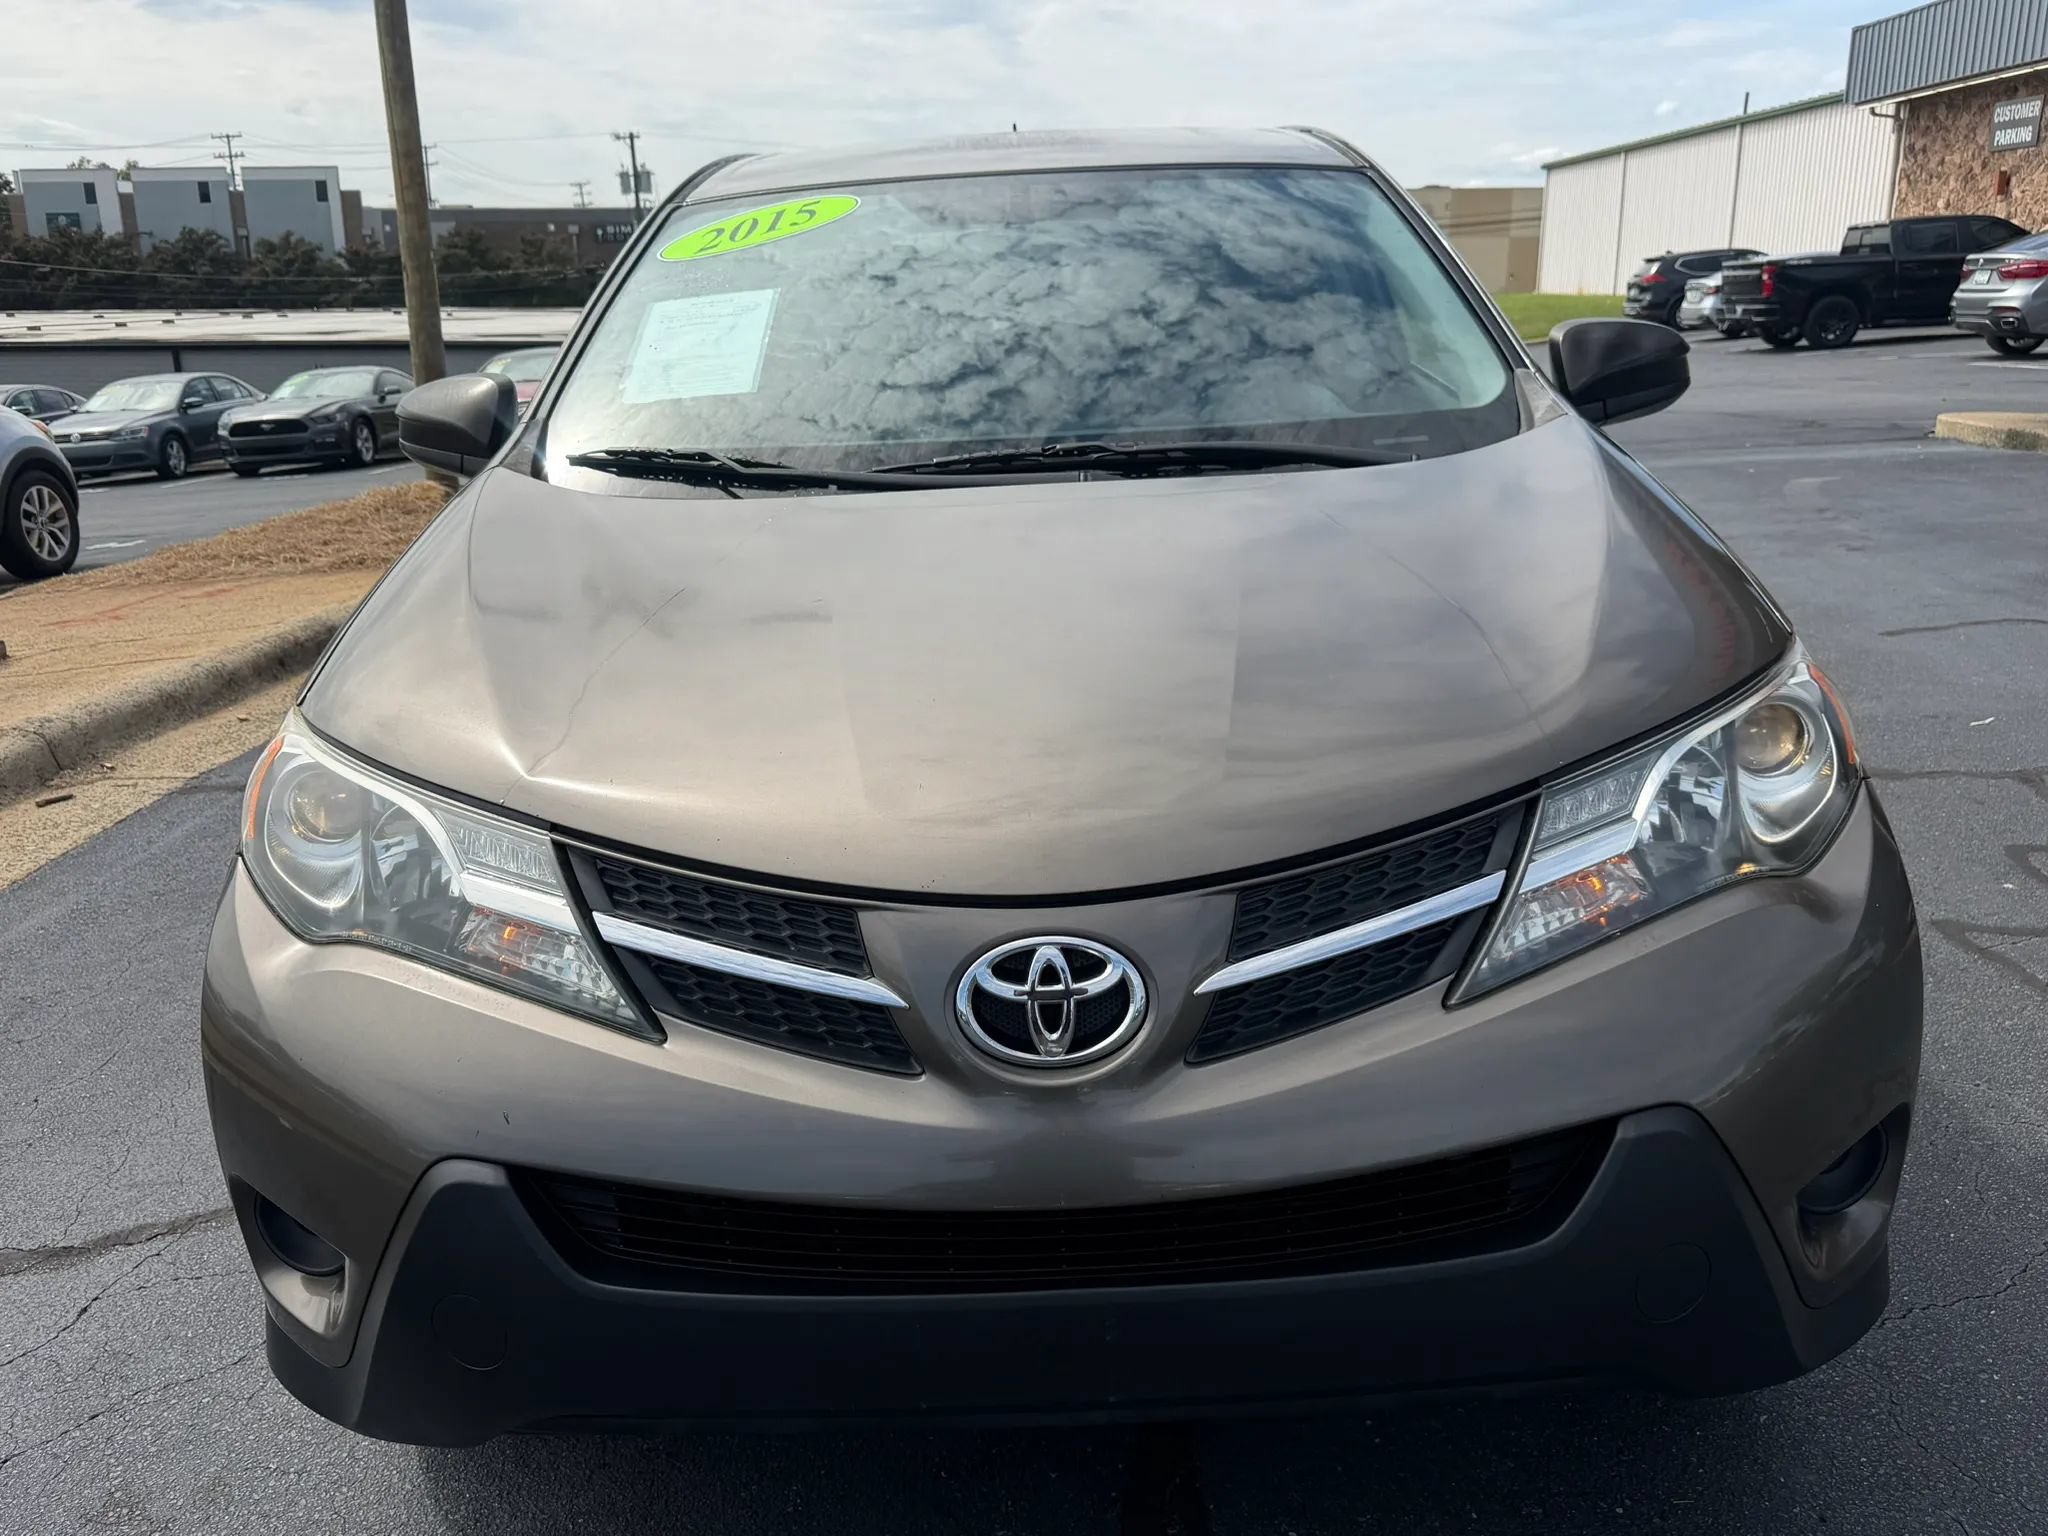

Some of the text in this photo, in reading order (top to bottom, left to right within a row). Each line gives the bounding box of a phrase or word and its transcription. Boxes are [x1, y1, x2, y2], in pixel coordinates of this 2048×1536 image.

[1994, 100, 2041, 123] CUSTOMER
[1994, 125, 2033, 146] PARKING
[693, 200, 821, 254] 2015
